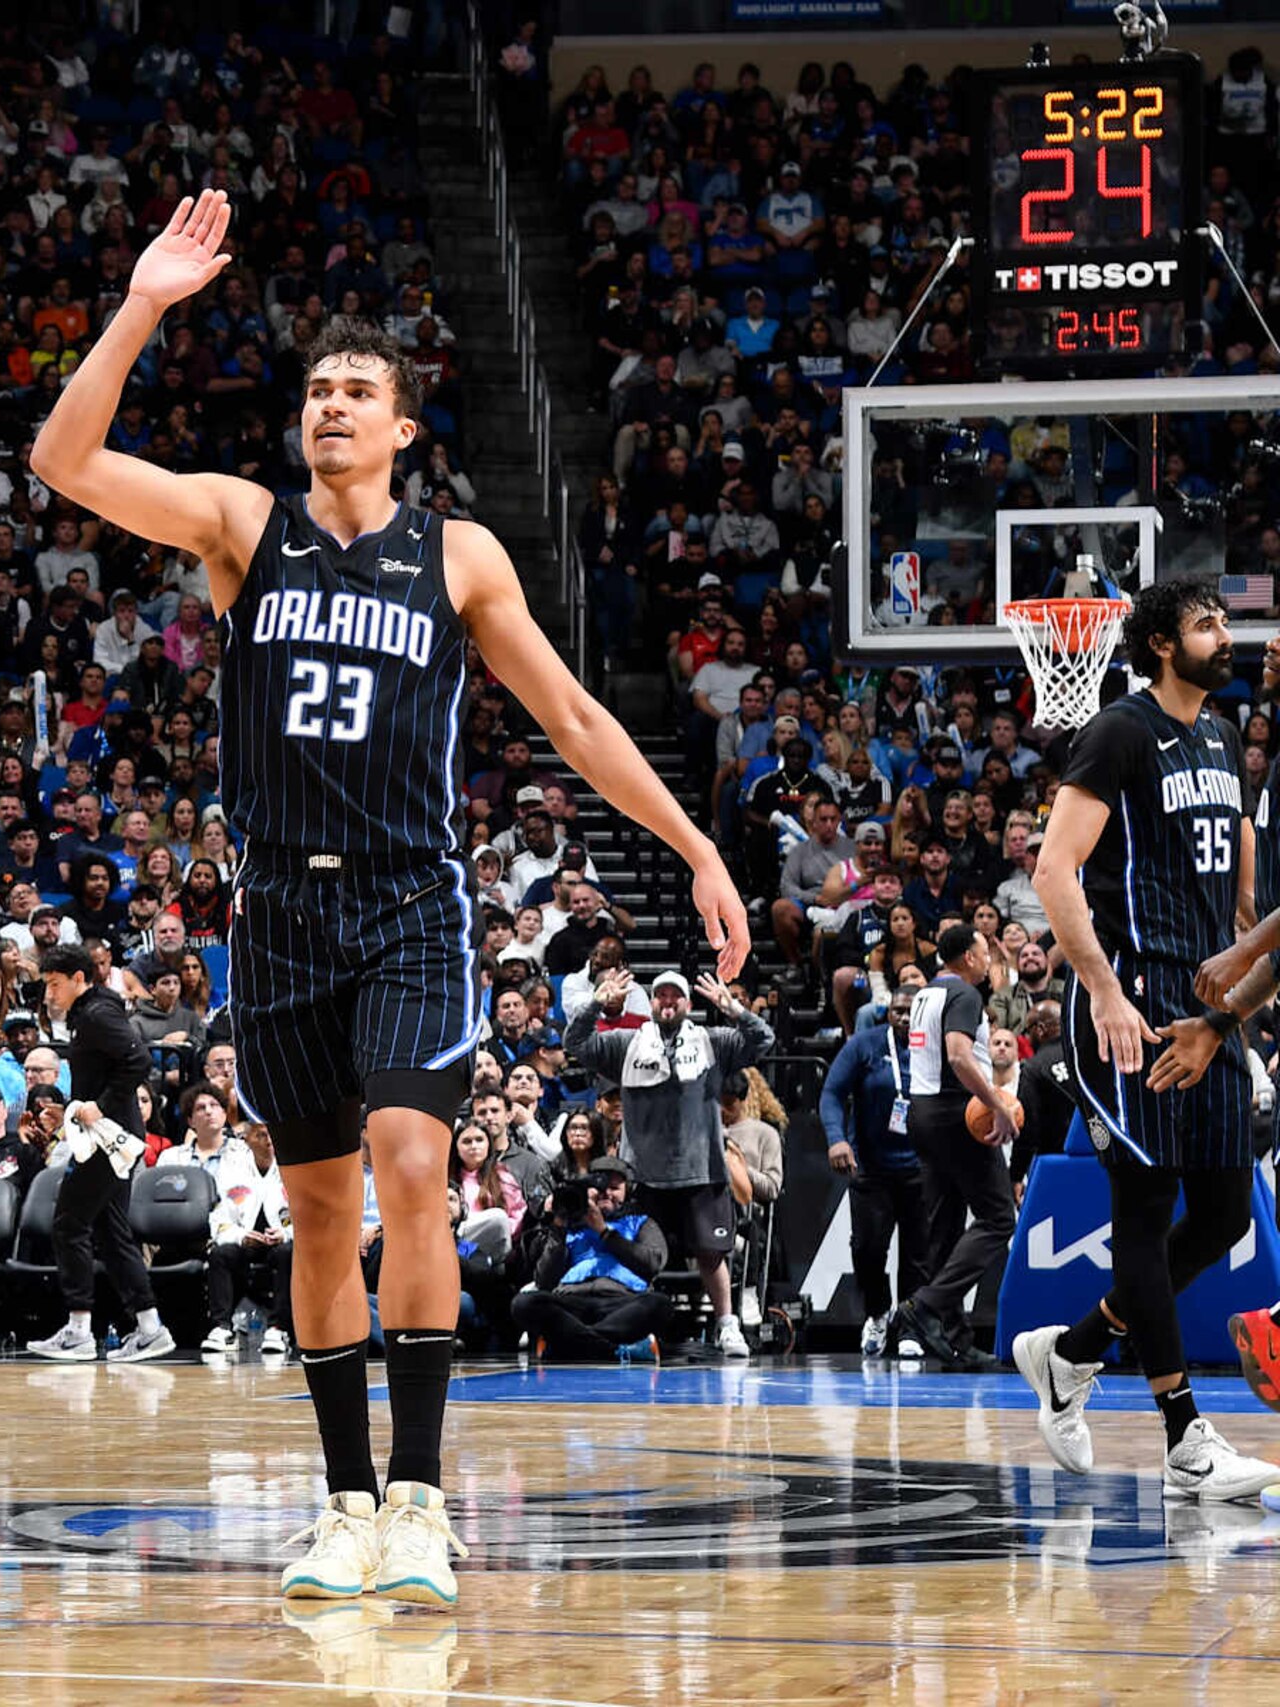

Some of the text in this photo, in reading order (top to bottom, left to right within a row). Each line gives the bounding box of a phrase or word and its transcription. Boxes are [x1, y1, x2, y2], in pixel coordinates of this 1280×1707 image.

[1044, 87, 1164, 142] 5:22
[1021, 144, 1152, 244] 24
[1044, 260, 1179, 291] TISSOT
[1057, 309, 1141, 350] 2:45
[377, 557, 423, 577] Disney
[253, 588, 434, 668] ORLANDO
[285, 658, 374, 742] 23
[1193, 817, 1232, 873] 35
